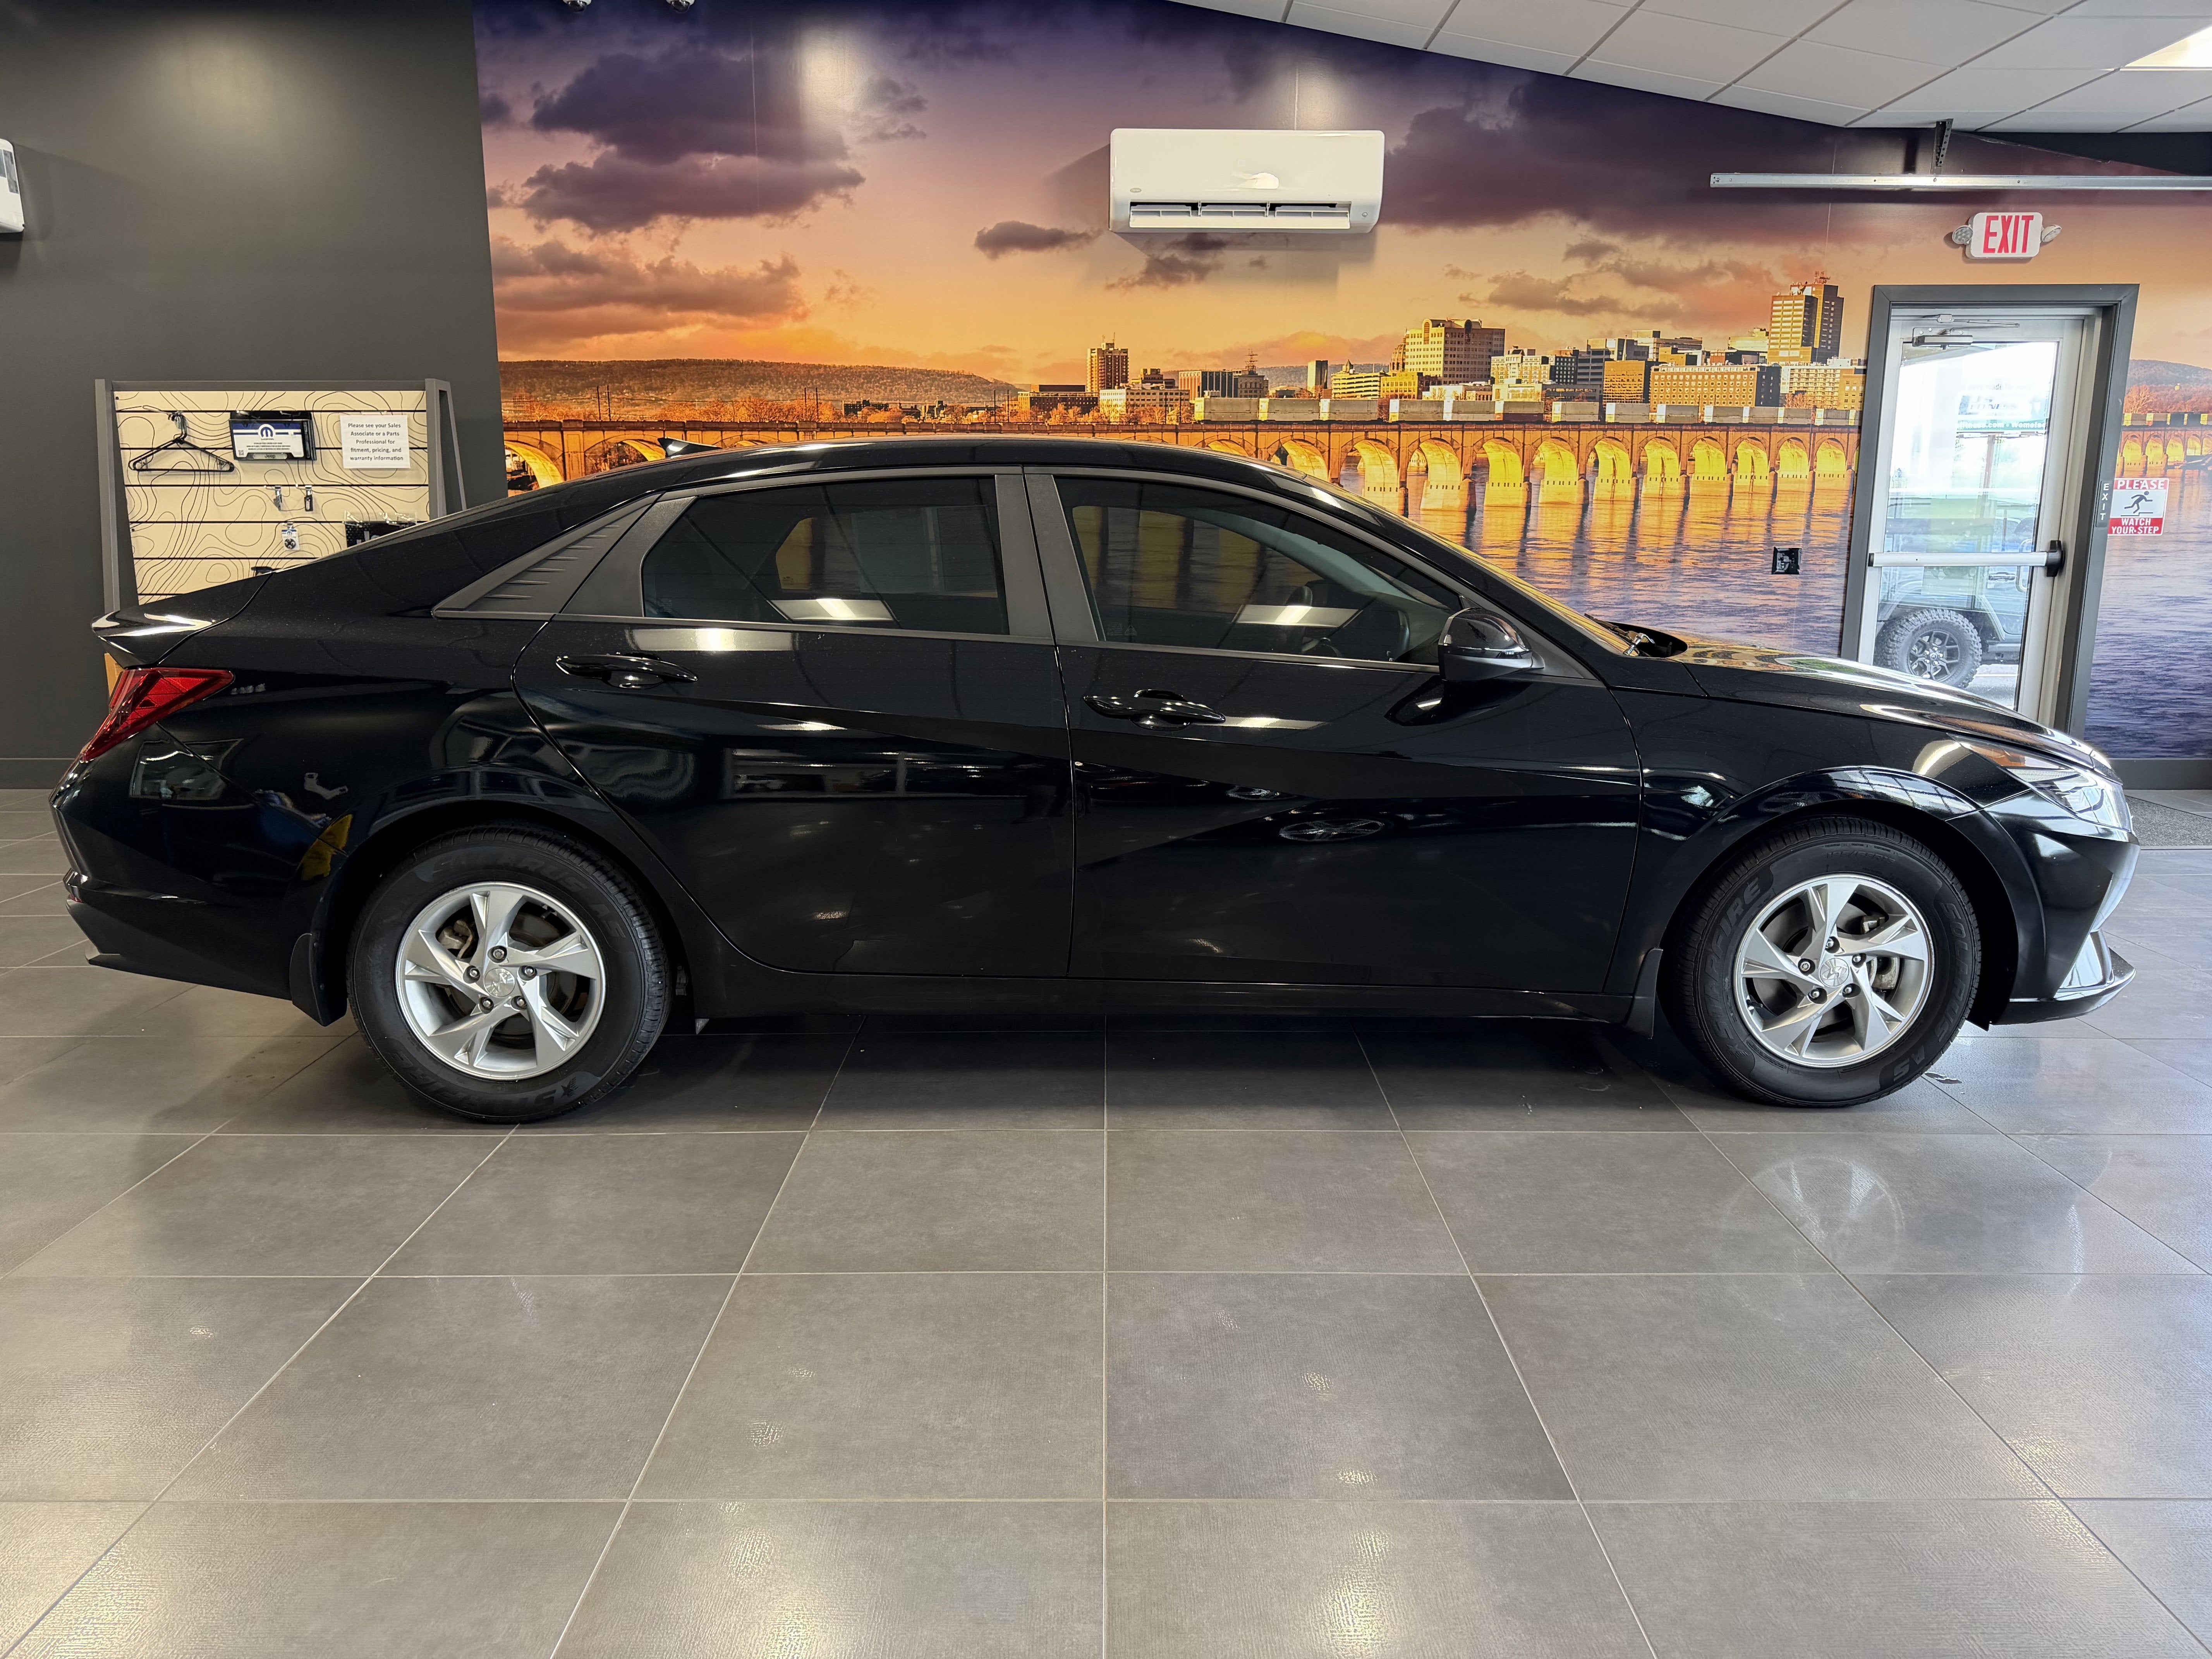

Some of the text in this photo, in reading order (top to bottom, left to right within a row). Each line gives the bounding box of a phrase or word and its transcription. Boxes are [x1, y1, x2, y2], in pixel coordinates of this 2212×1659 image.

[1983, 215, 2034, 253] EXIT
[2100, 483, 2109, 520] EXIT
[2117, 480, 2165, 489] PLEASE
[1893, 902, 1969, 1082] SOLARUS AS
